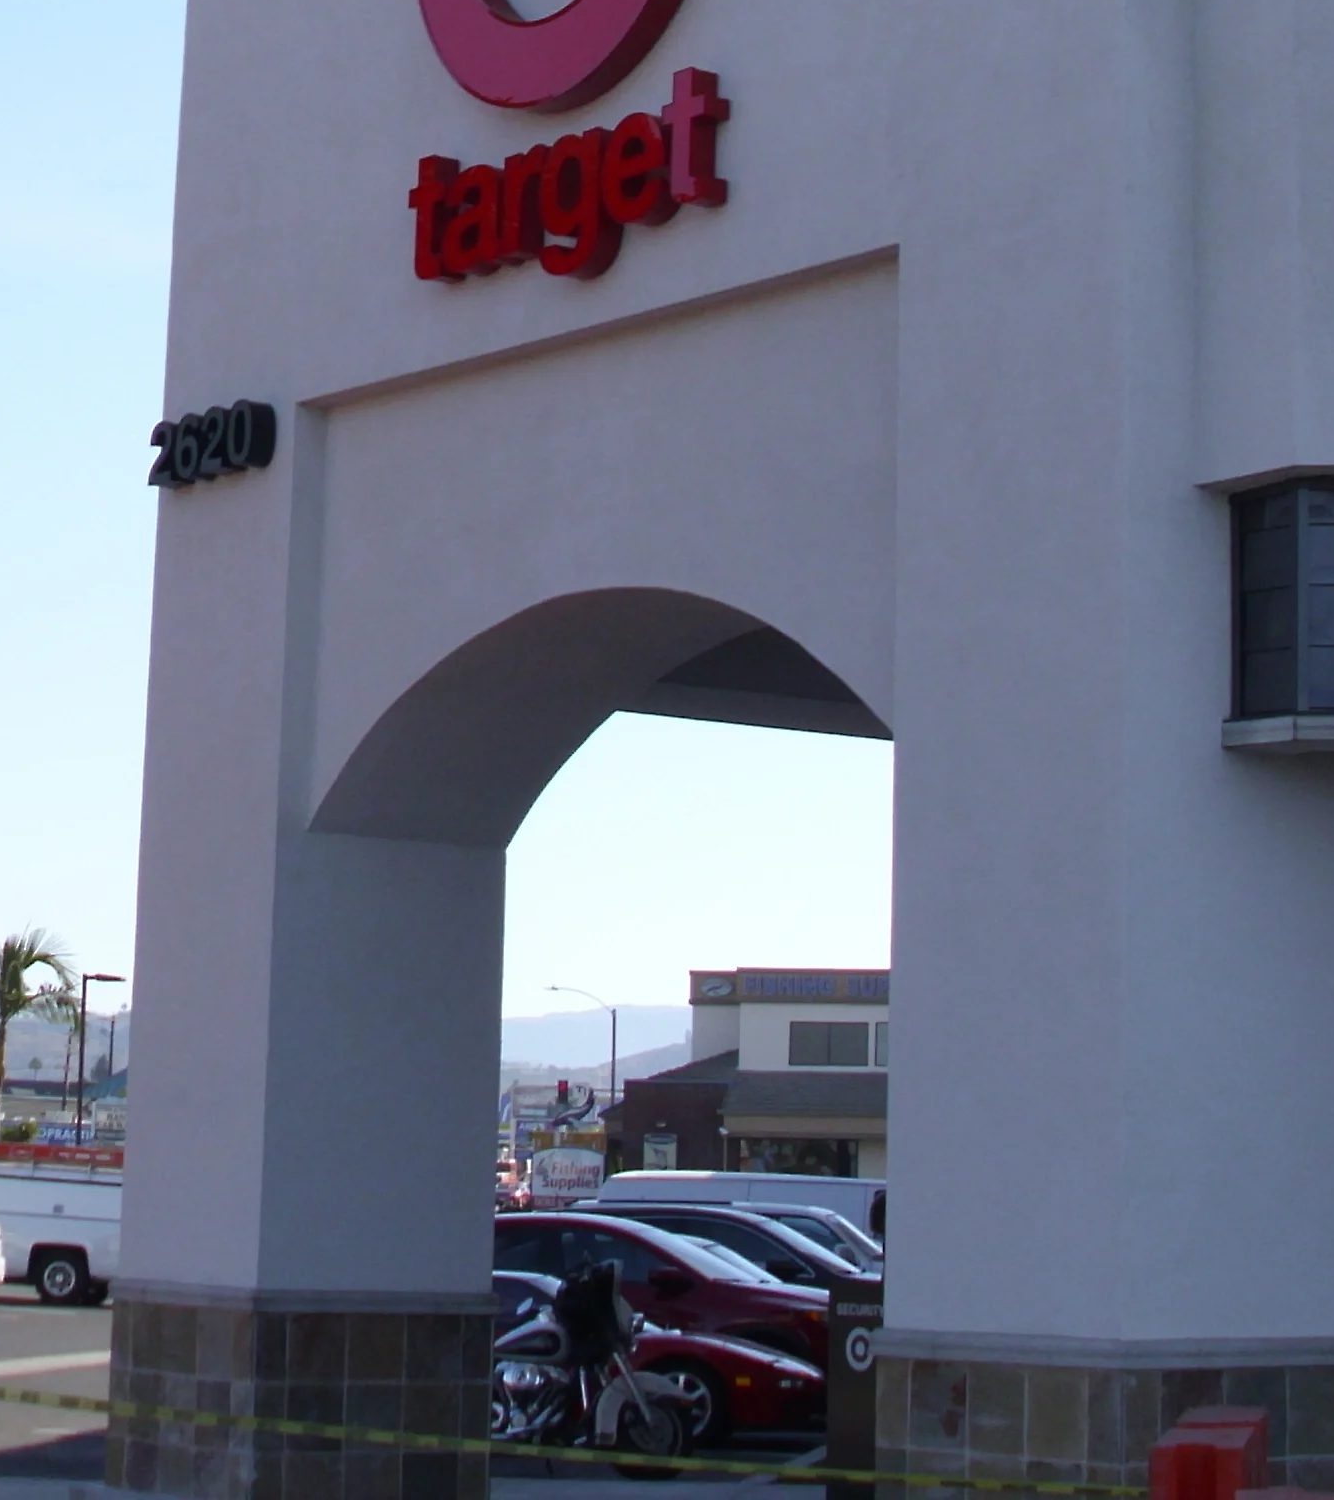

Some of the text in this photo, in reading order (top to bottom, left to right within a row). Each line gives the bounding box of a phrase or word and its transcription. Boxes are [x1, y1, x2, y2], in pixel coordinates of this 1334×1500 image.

[408, 67, 730, 283] target
[147, 398, 276, 488] 2620
[743, 974, 834, 996] FISHING
[551, 1160, 601, 1179] Fishing
[542, 1176, 600, 1190] Supplies
